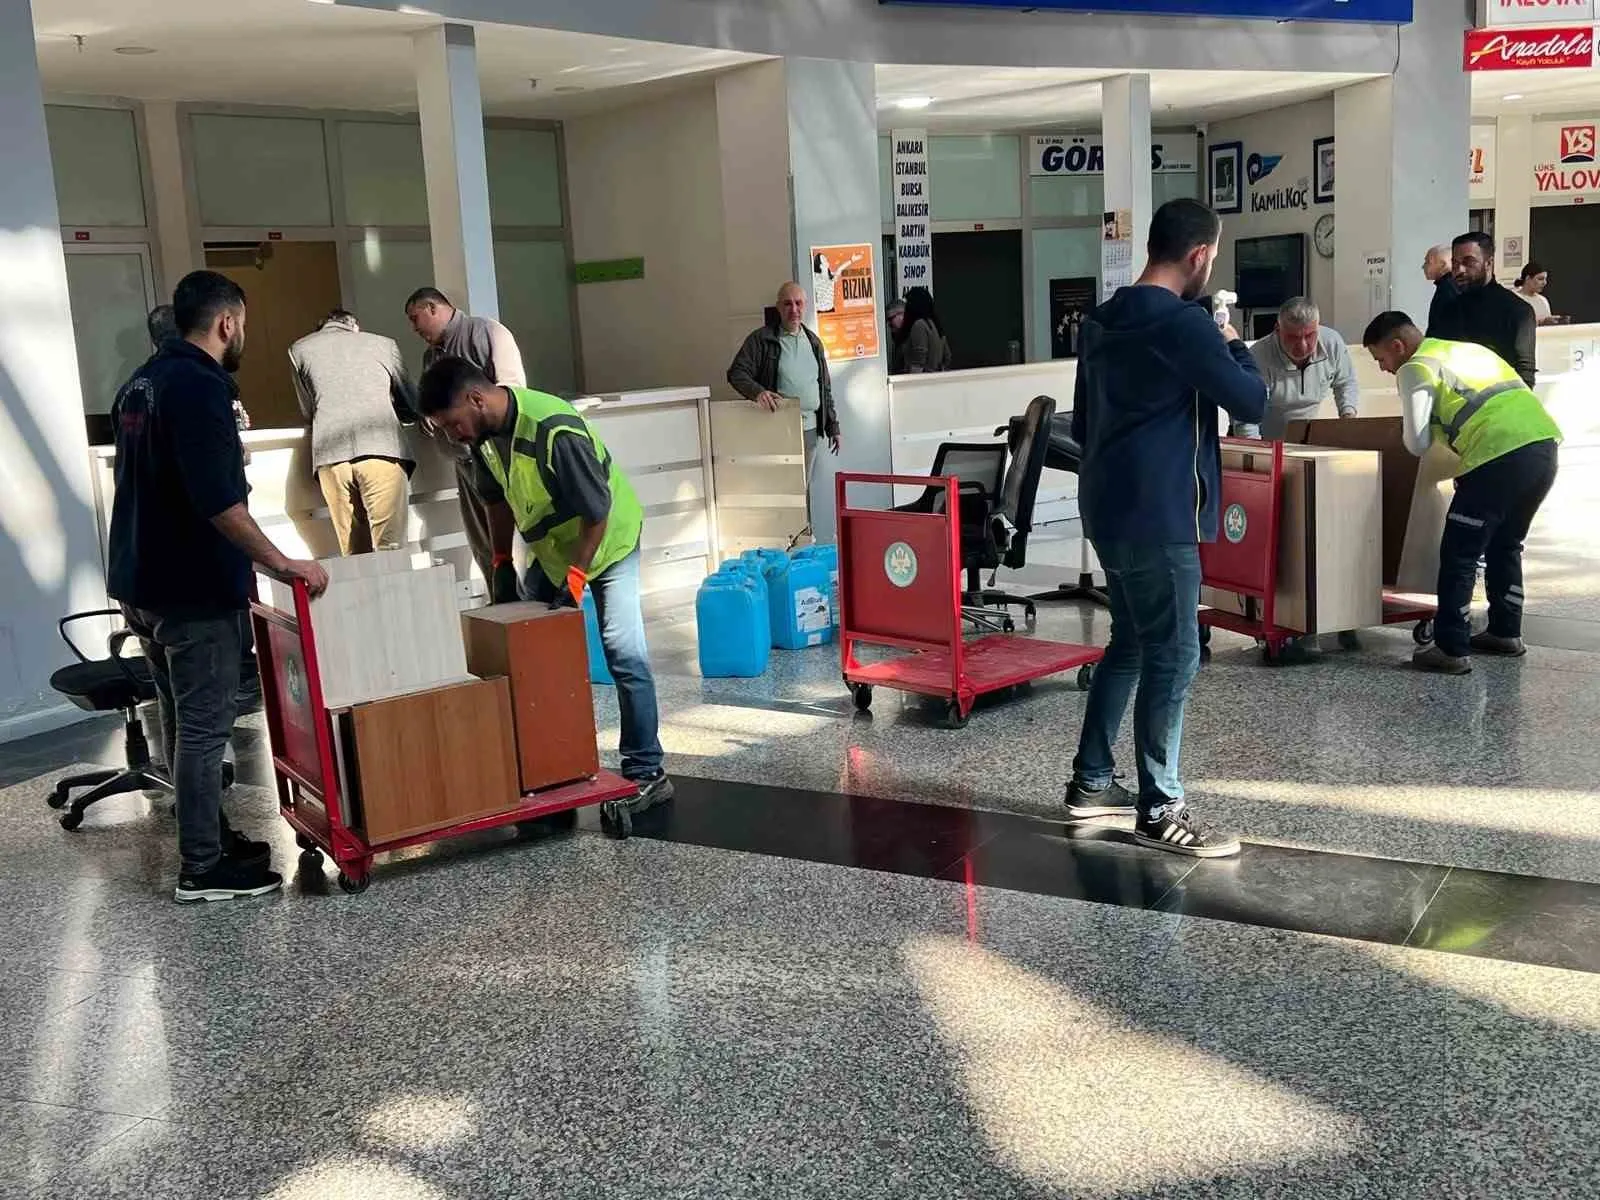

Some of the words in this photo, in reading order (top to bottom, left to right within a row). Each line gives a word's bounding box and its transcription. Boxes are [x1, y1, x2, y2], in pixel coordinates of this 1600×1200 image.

[1470, 33, 1591, 64] Anadolu
[897, 140, 923, 154] ANKARA
[1564, 129, 1594, 154] YS
[1041, 137, 1163, 172] GÖRS
[1535, 170, 1600, 191] YALOV
[901, 183, 922, 196] BURSA
[901, 224, 925, 238] BARTIN
[899, 241, 930, 258] KARABÜK
[904, 262, 925, 278] SİNOP
